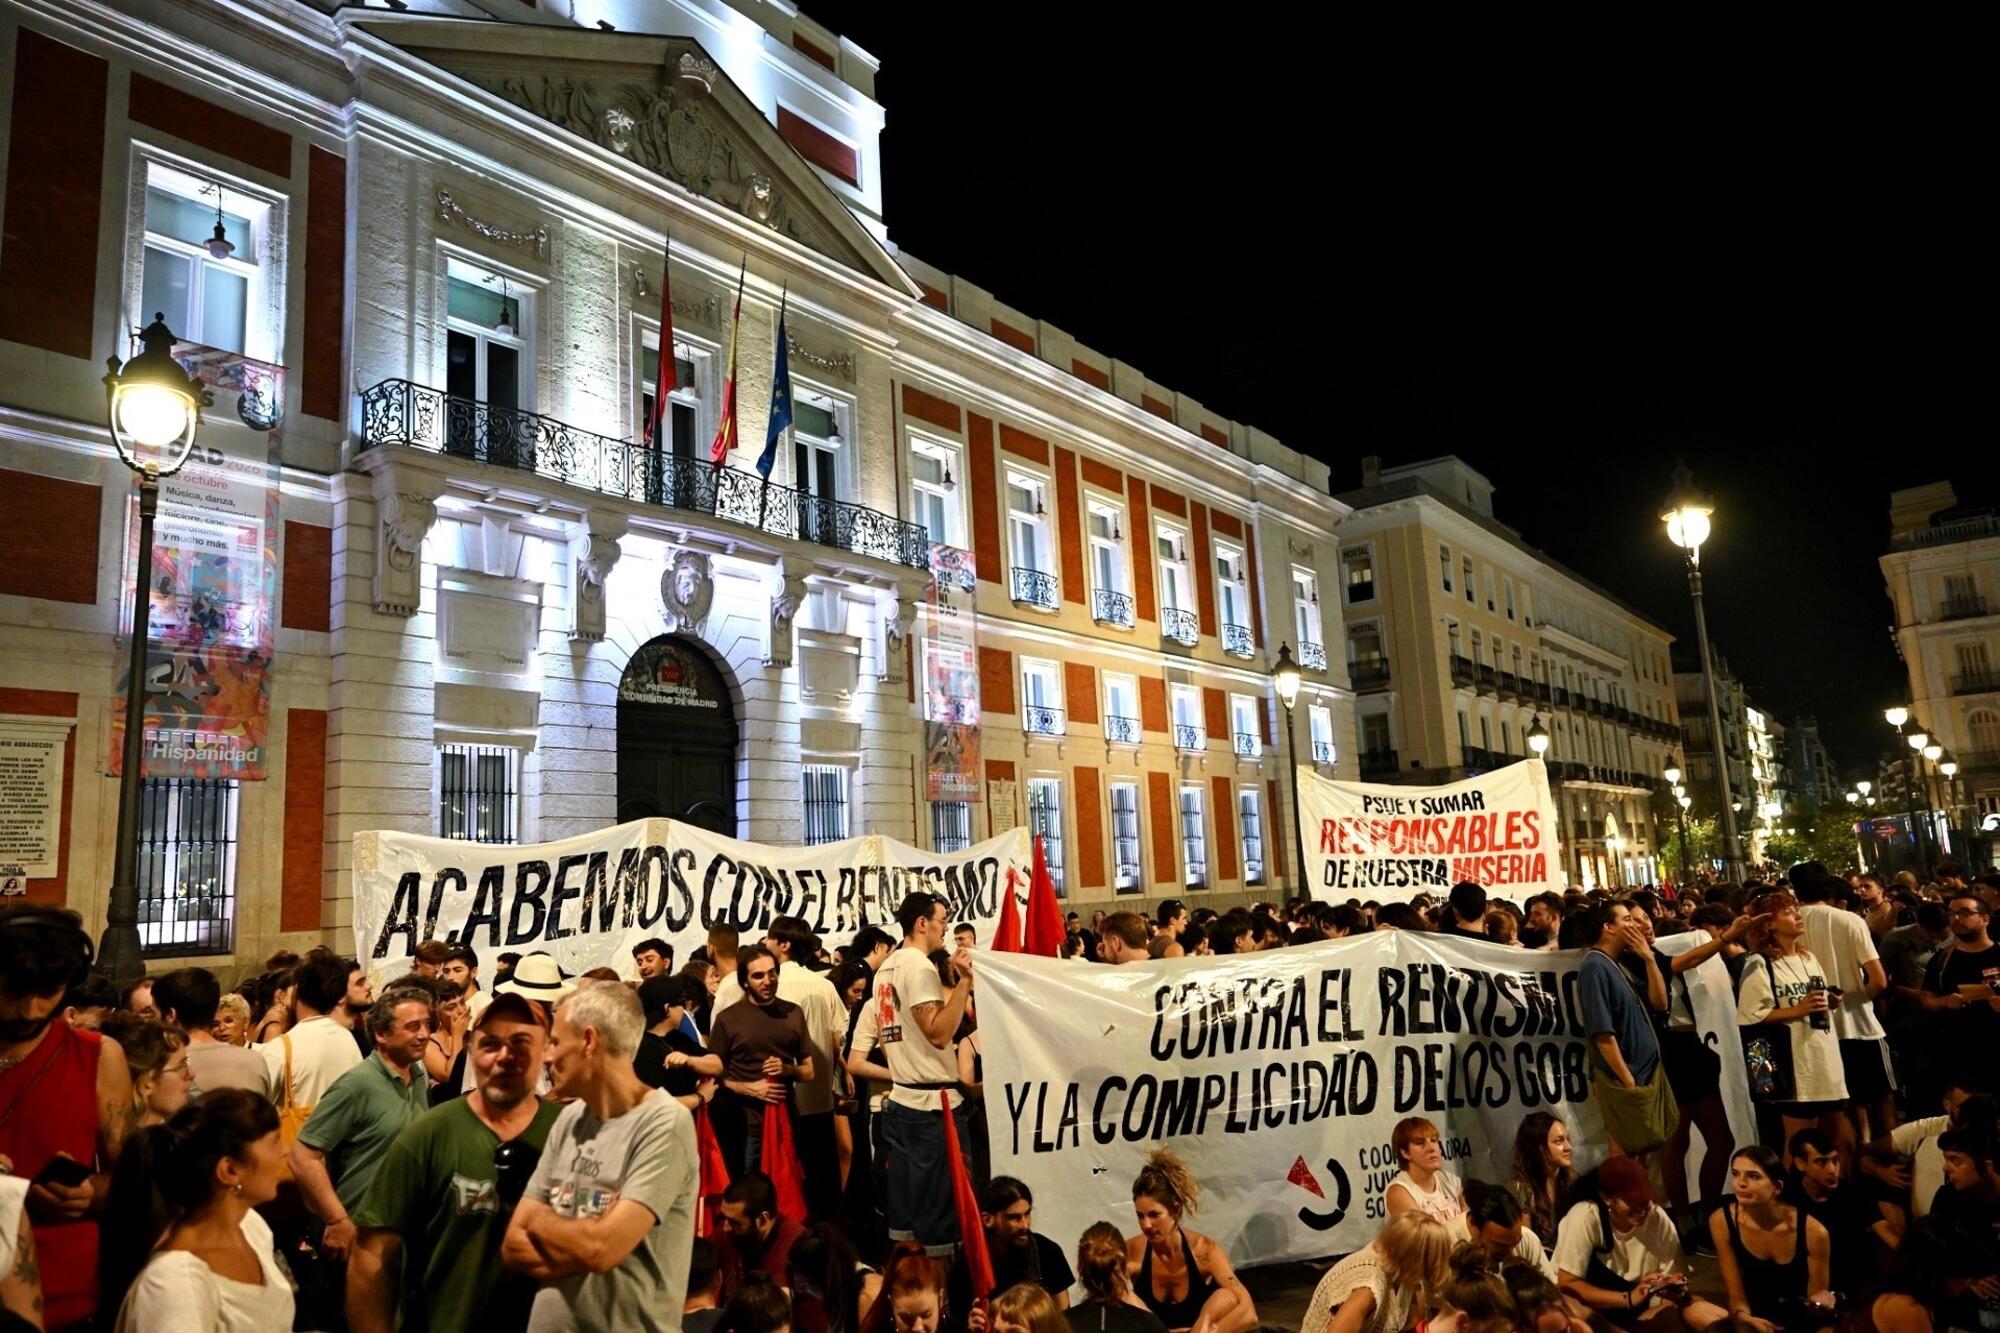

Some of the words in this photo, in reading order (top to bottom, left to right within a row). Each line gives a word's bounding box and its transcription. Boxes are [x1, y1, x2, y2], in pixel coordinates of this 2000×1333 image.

[165, 486, 203, 501] Música,
[205, 493, 236, 507] danza,
[170, 533, 204, 546] mucho
[206, 540, 230, 550] más.
[624, 691, 674, 705] COMUNIDAD
[675, 696, 687, 706] DE
[687, 698, 718, 709] MADRID
[646, 683, 698, 697] PRESIDENCIA
[152, 743, 259, 763] Hispanidad
[1408, 798, 1418, 815] Y
[1421, 789, 1486, 816] SUMAR
[1319, 810, 1540, 855] RESPONSABLES
[1323, 859, 1351, 888] DE
[1351, 858, 1450, 889] NUESTRA
[1451, 853, 1548, 888] MISERIA
[372, 845, 697, 959] ACABEMOS
[700, 852, 793, 933] CON
[795, 869, 830, 934] EL
[1150, 975, 1309, 1061] CONTRA
[1317, 968, 1365, 1042] EL
[1378, 963, 1586, 1038] RENTISMO
[1004, 1081, 1032, 1155] Y
[1033, 1081, 1080, 1153] LA
[1093, 1050, 1378, 1145] COMPLICIDAD
[1393, 1044, 1445, 1113] DE
[1446, 1041, 1511, 1108] LOS
[1514, 1041, 1595, 1108] GOB
